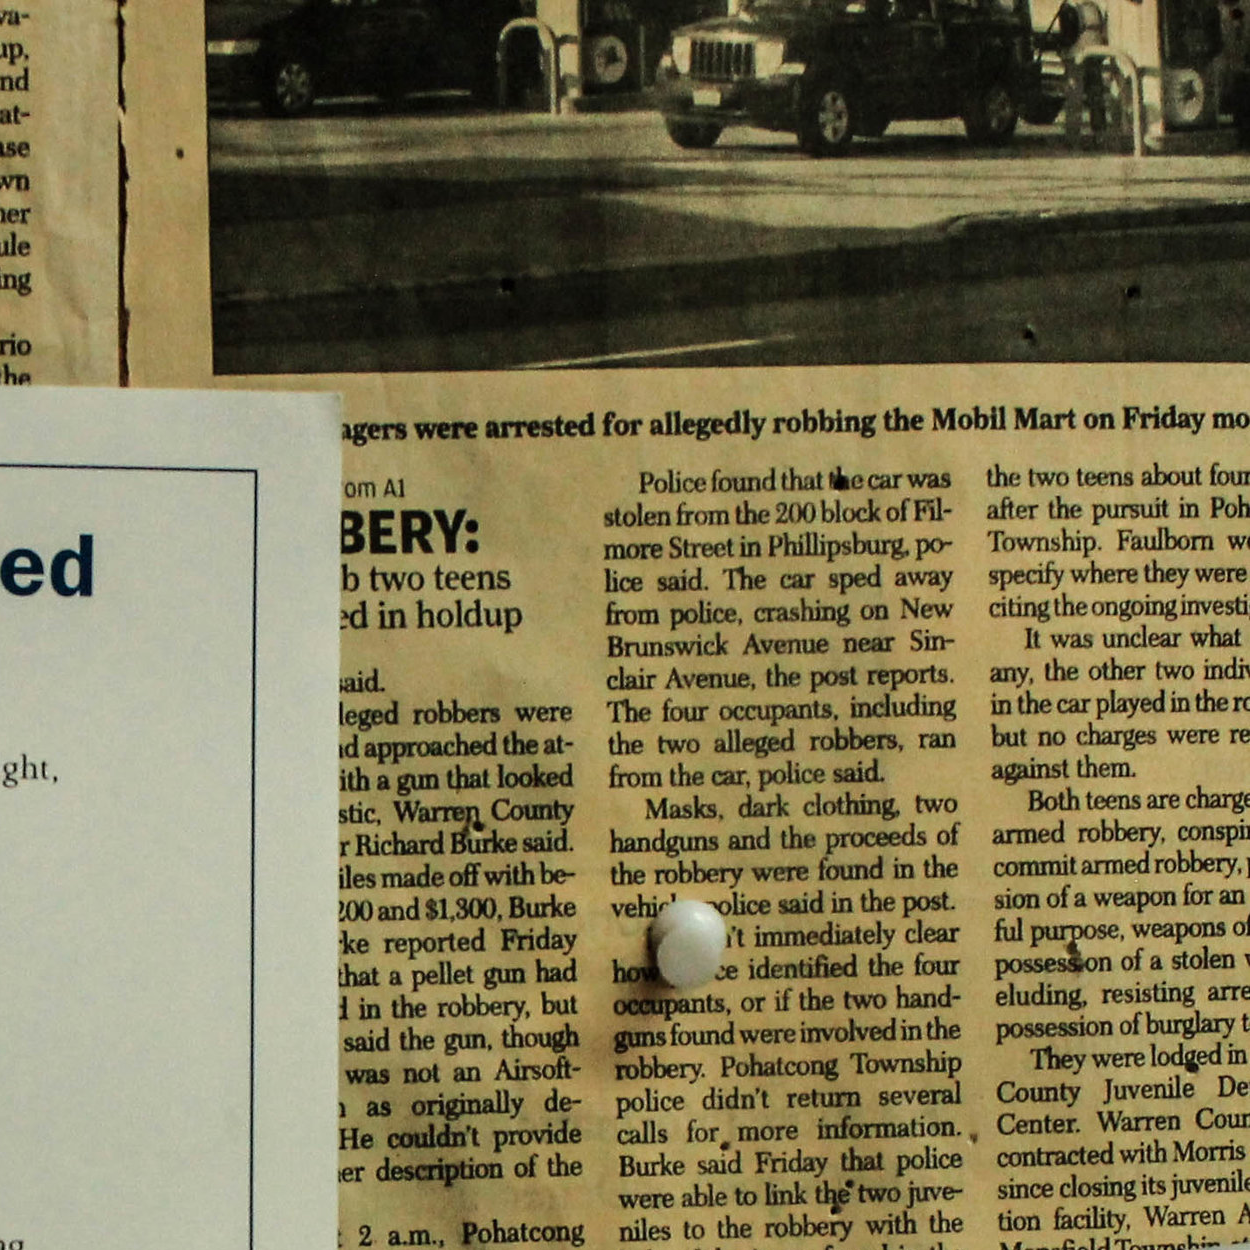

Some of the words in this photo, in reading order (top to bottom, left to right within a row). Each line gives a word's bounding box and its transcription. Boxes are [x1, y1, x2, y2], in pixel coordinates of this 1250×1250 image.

[413, 420, 479, 441] were
[485, 410, 596, 440] arrested
[602, 410, 644, 438] for
[649, 408, 767, 442] allegedly
[772, 406, 877, 440] robbing
[883, 406, 925, 433] the
[932, 404, 1007, 432] Mobil
[1013, 406, 1077, 432] Mart
[1083, 411, 1116, 431] on
[1122, 403, 1206, 436] Friday
[383, 479, 405, 497] A1
[638, 468, 707, 495] Police
[711, 466, 777, 494] found
[780, 466, 824, 493] that
[867, 472, 903, 492] car
[906, 472, 952, 490] was
[369, 565, 425, 593] two
[433, 564, 512, 592] teens
[378, 599, 407, 630] in
[415, 597, 523, 636] holdup
[607, 631, 729, 659] Brunswick
[742, 632, 830, 657] Avenue
[842, 635, 896, 654] near
[910, 628, 956, 653] Sin-
[1024, 626, 1041, 650] It
[1050, 632, 1094, 650] was
[1102, 623, 1182, 650] unclear
[1190, 623, 1242, 649] what
[995, 1019, 1114, 1047] possession
[1119, 1013, 1140, 1037] of
[1145, 1012, 1236, 1041] burglary
[614, 1055, 706, 1085] robbery.
[720, 1053, 840, 1082] Pohatcong
[849, 1051, 963, 1086] Township
[386, 1122, 481, 1150] couldn't
[492, 1120, 582, 1154] provide
